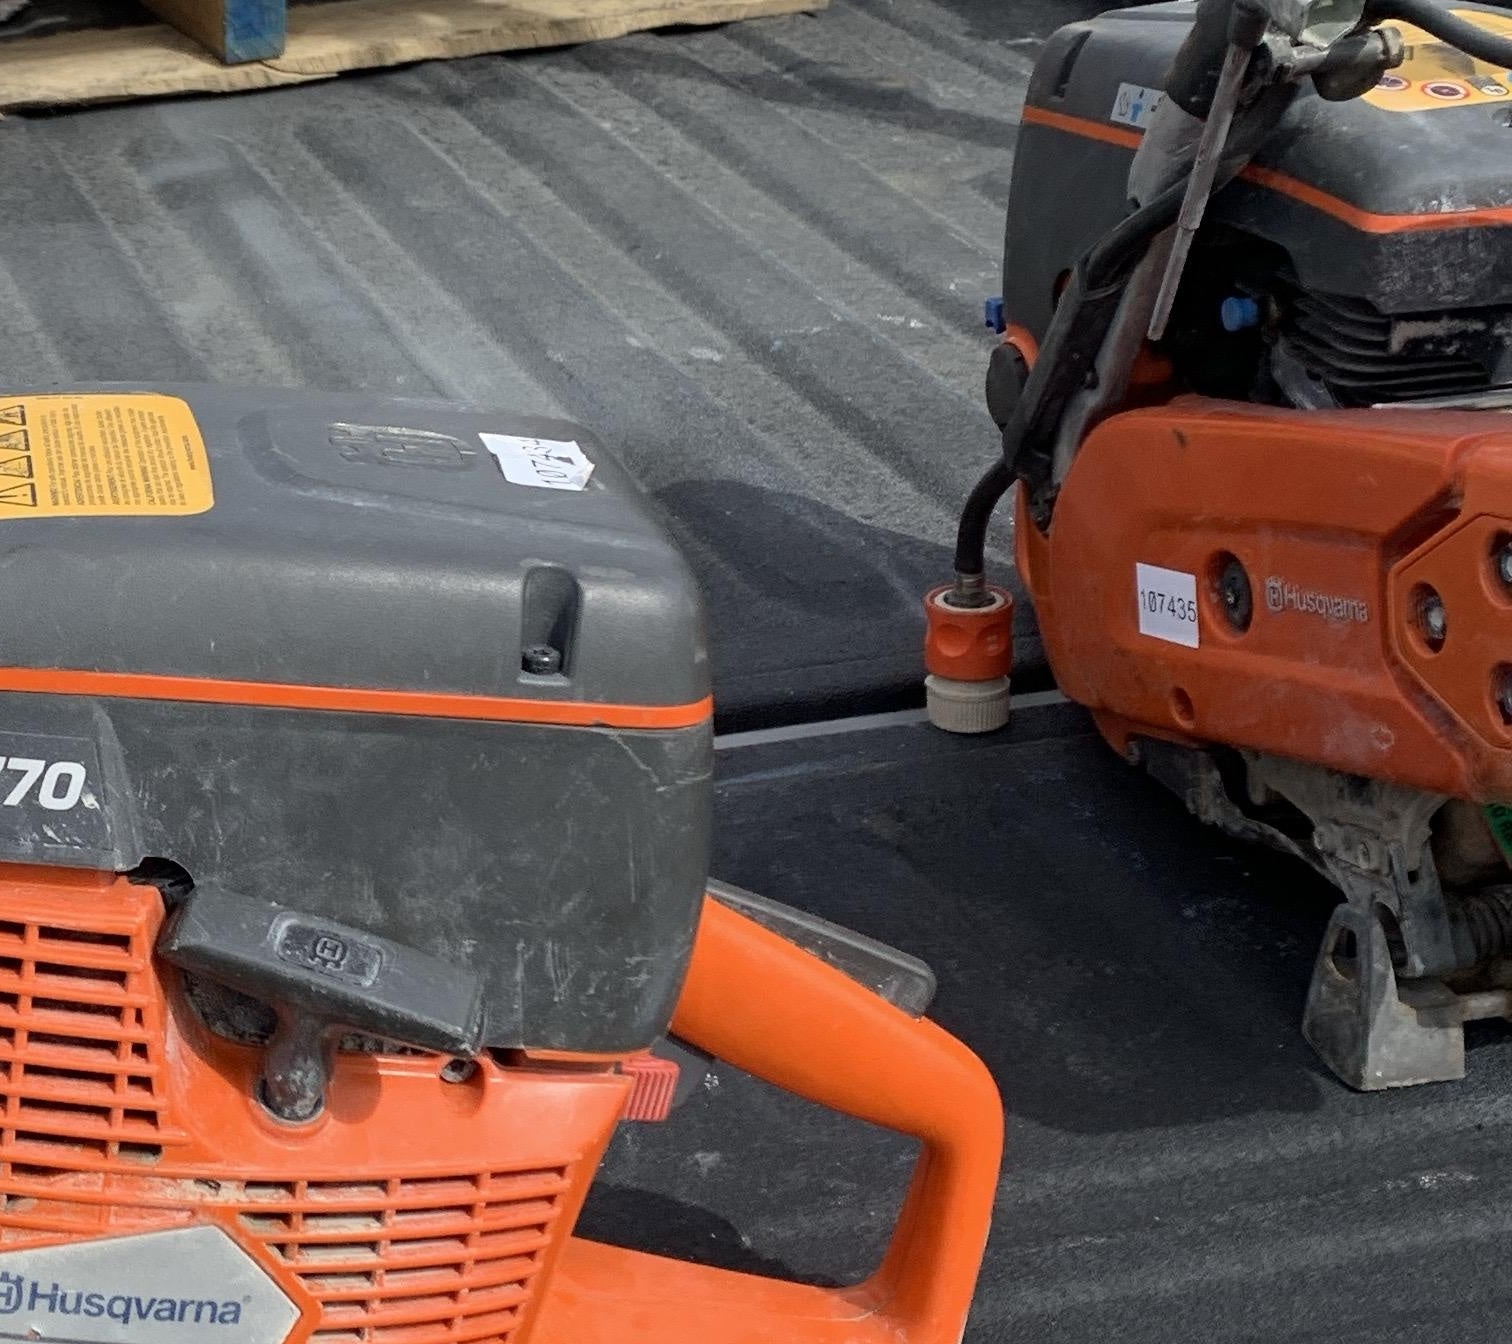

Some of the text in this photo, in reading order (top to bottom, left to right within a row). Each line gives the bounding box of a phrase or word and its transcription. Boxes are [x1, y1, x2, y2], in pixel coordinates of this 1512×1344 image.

[1140, 587, 1197, 623] 107435
[1284, 580, 1370, 624] Husqvarna
[27, 1280, 241, 1325] Husqvarna
